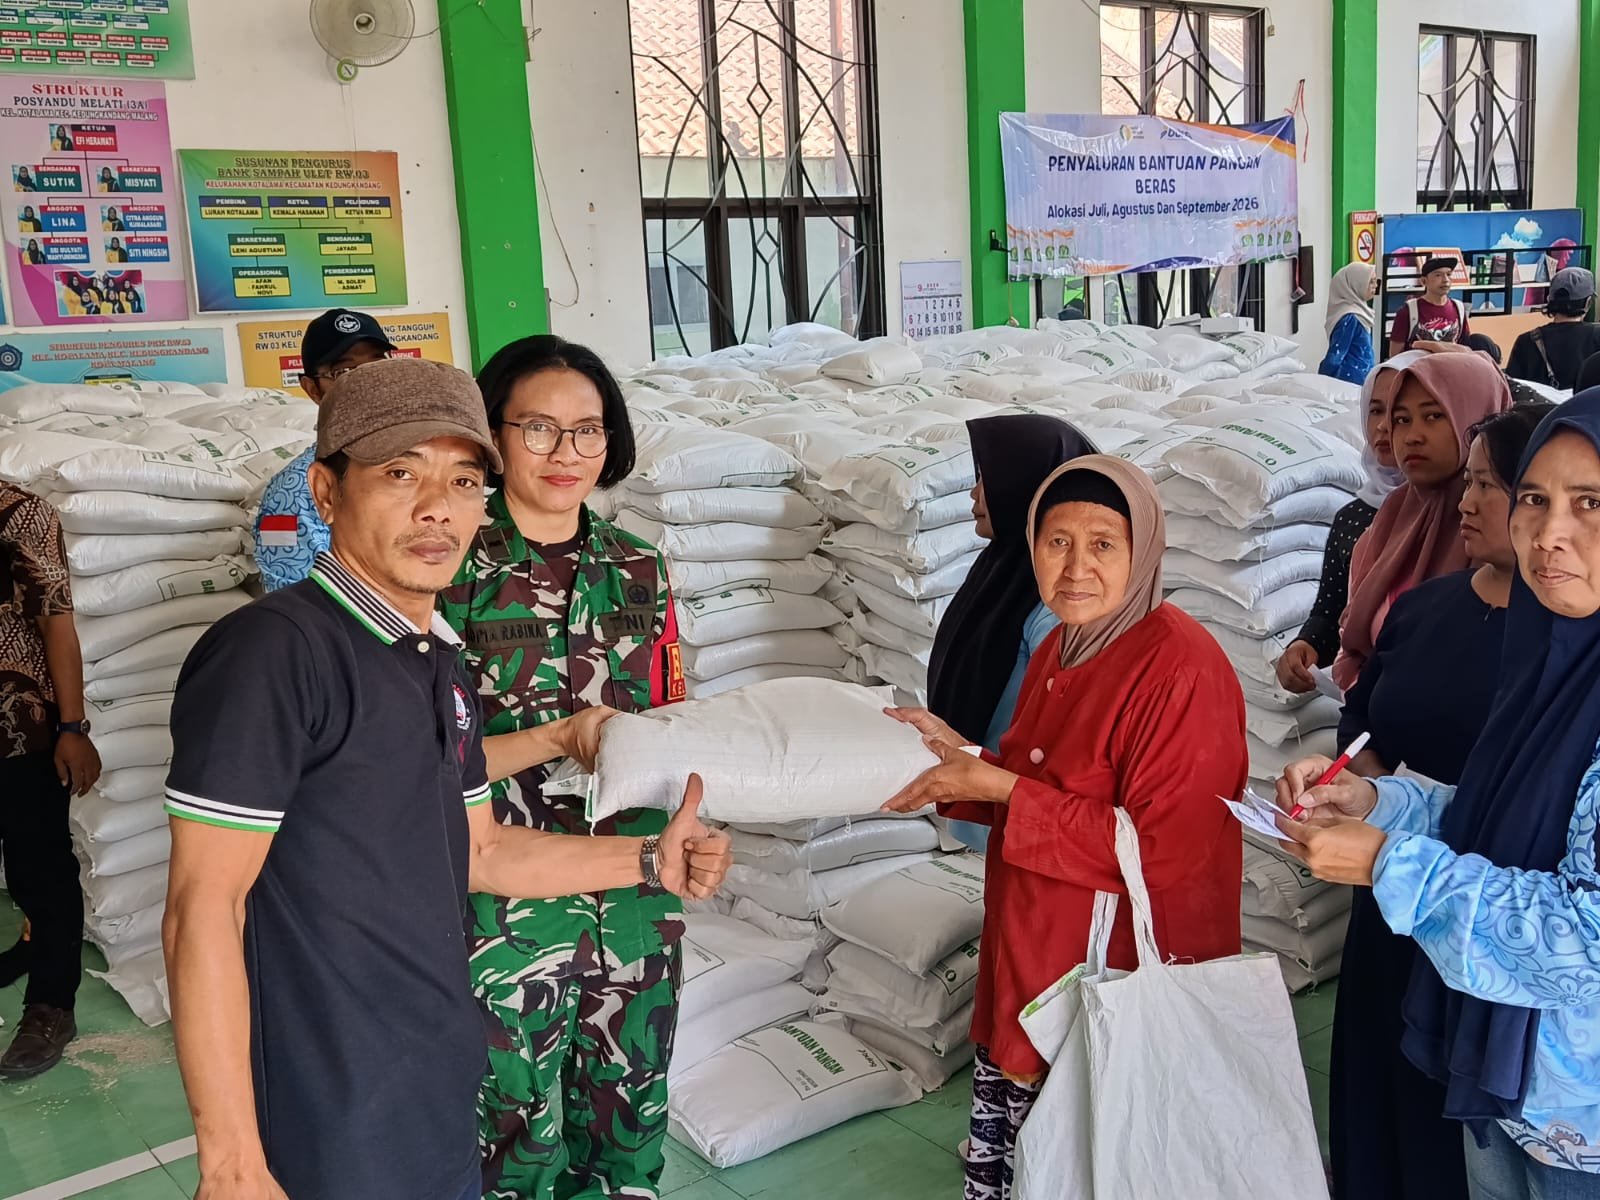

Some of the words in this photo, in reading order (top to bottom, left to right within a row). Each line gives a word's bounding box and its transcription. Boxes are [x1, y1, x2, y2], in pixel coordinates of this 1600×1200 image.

[32, 83, 124, 97] STRUKTUR
[14, 96, 76, 107] POSYANDU
[80, 98, 122, 109] MELATI
[17, 109, 54, 118] KOTALAMA
[72, 110, 130, 120] KEDUNGKANDANG
[131, 112, 158, 121] MALANG
[234, 157, 288, 168] SUSUNAN
[291, 158, 351, 168] PENGURUS
[1048, 155, 1135, 172] PENYALURAN
[1139, 155, 1206, 170] BANTUAN
[1210, 155, 1261, 170] PANGAN
[217, 168, 249, 178] BANK
[252, 168, 300, 179] SAMPAH
[43, 177, 75, 187] SUTIK
[124, 178, 157, 188] MISYATI
[1135, 178, 1176, 194] BERAS
[1047, 203, 1086, 218] Alokasi
[1088, 202, 1109, 218] Juli,
[1112, 203, 1155, 220] Agustus
[1157, 202, 1175, 214] Dan
[1177, 200, 1230, 217] September
[1232, 197, 1259, 211] 2026
[51, 217, 76, 227] LINA
[129, 248, 141, 257] SITI
[909, 314, 913, 324] 6
[917, 314, 921, 323] 7
[925, 313, 929, 323] 8
[933, 313, 937, 322] 9
[940, 312, 946, 322] 10
[948, 312, 954, 321] 11
[956, 312, 962, 320] 12
[258, 330, 302, 340] STRUKTUR
[397, 323, 435, 332] TANGGUH
[811, 1047, 845, 1075] PANGAN
